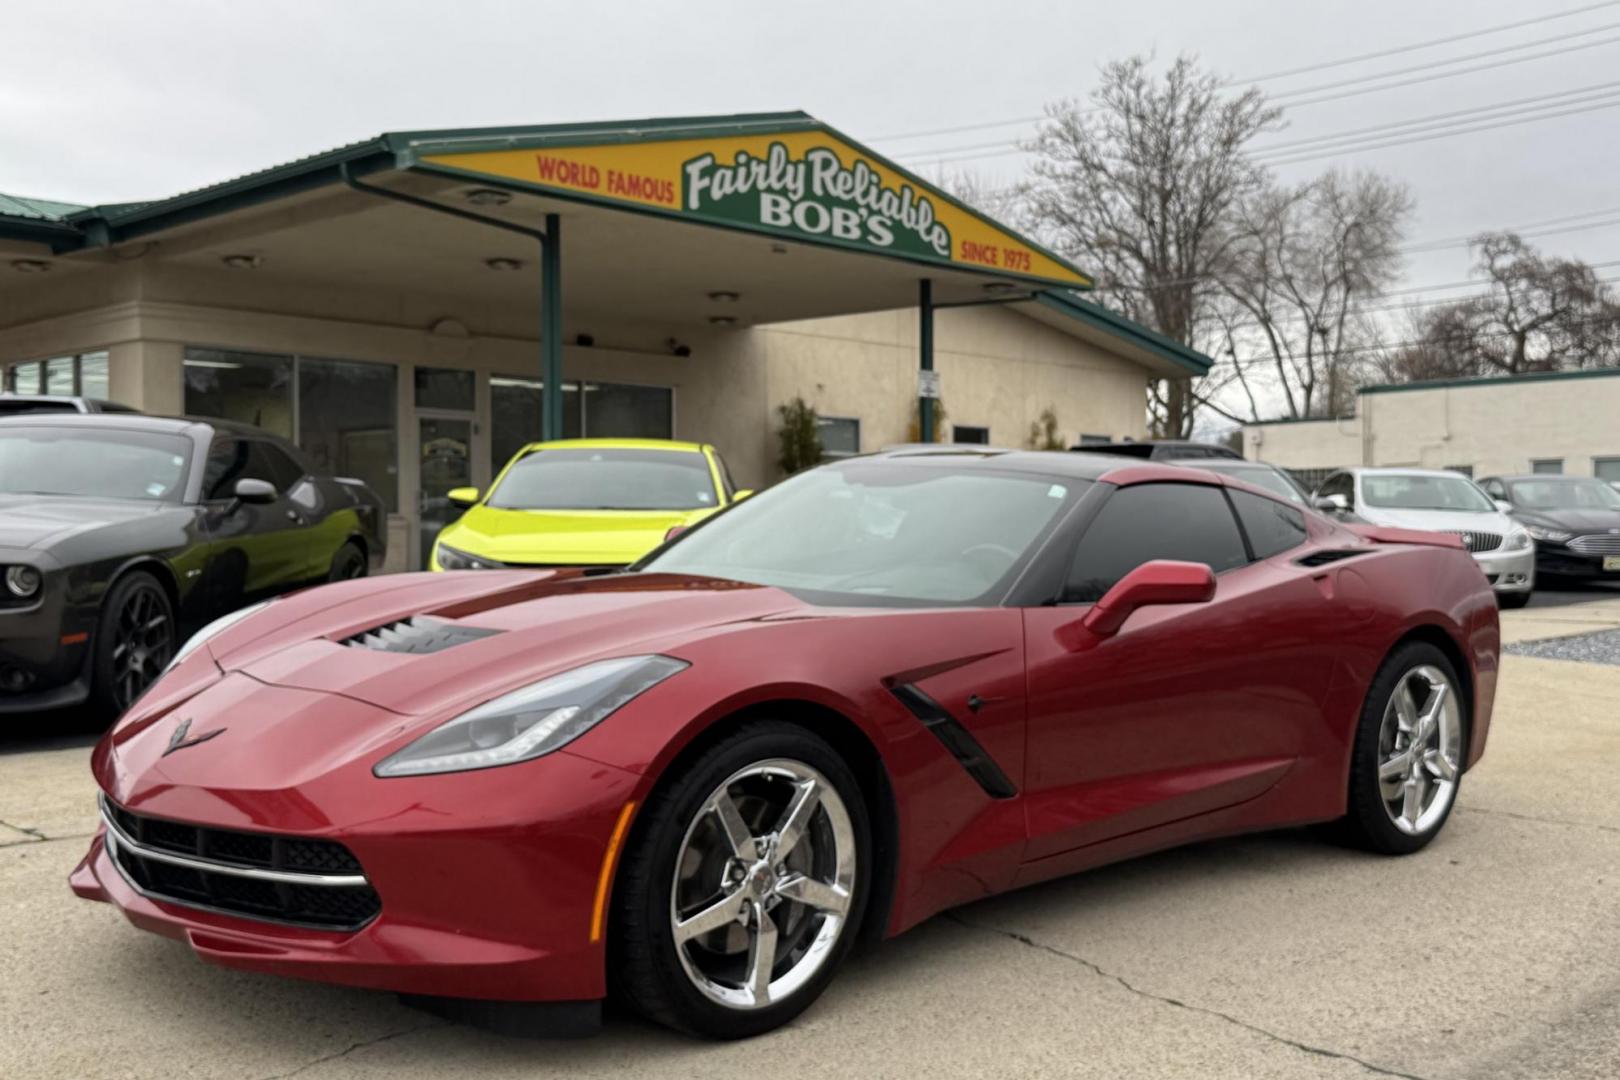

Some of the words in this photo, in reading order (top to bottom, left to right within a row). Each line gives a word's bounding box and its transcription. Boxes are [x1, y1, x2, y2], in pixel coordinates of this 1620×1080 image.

[537, 155, 599, 189] WORLD
[607, 170, 674, 203] FAMOUS
[685, 144, 806, 210] Fairly
[807, 149, 949, 256] Reliable
[760, 192, 894, 246] BOB'S
[961, 241, 998, 266] SINCE
[1003, 248, 1031, 272] 1975
